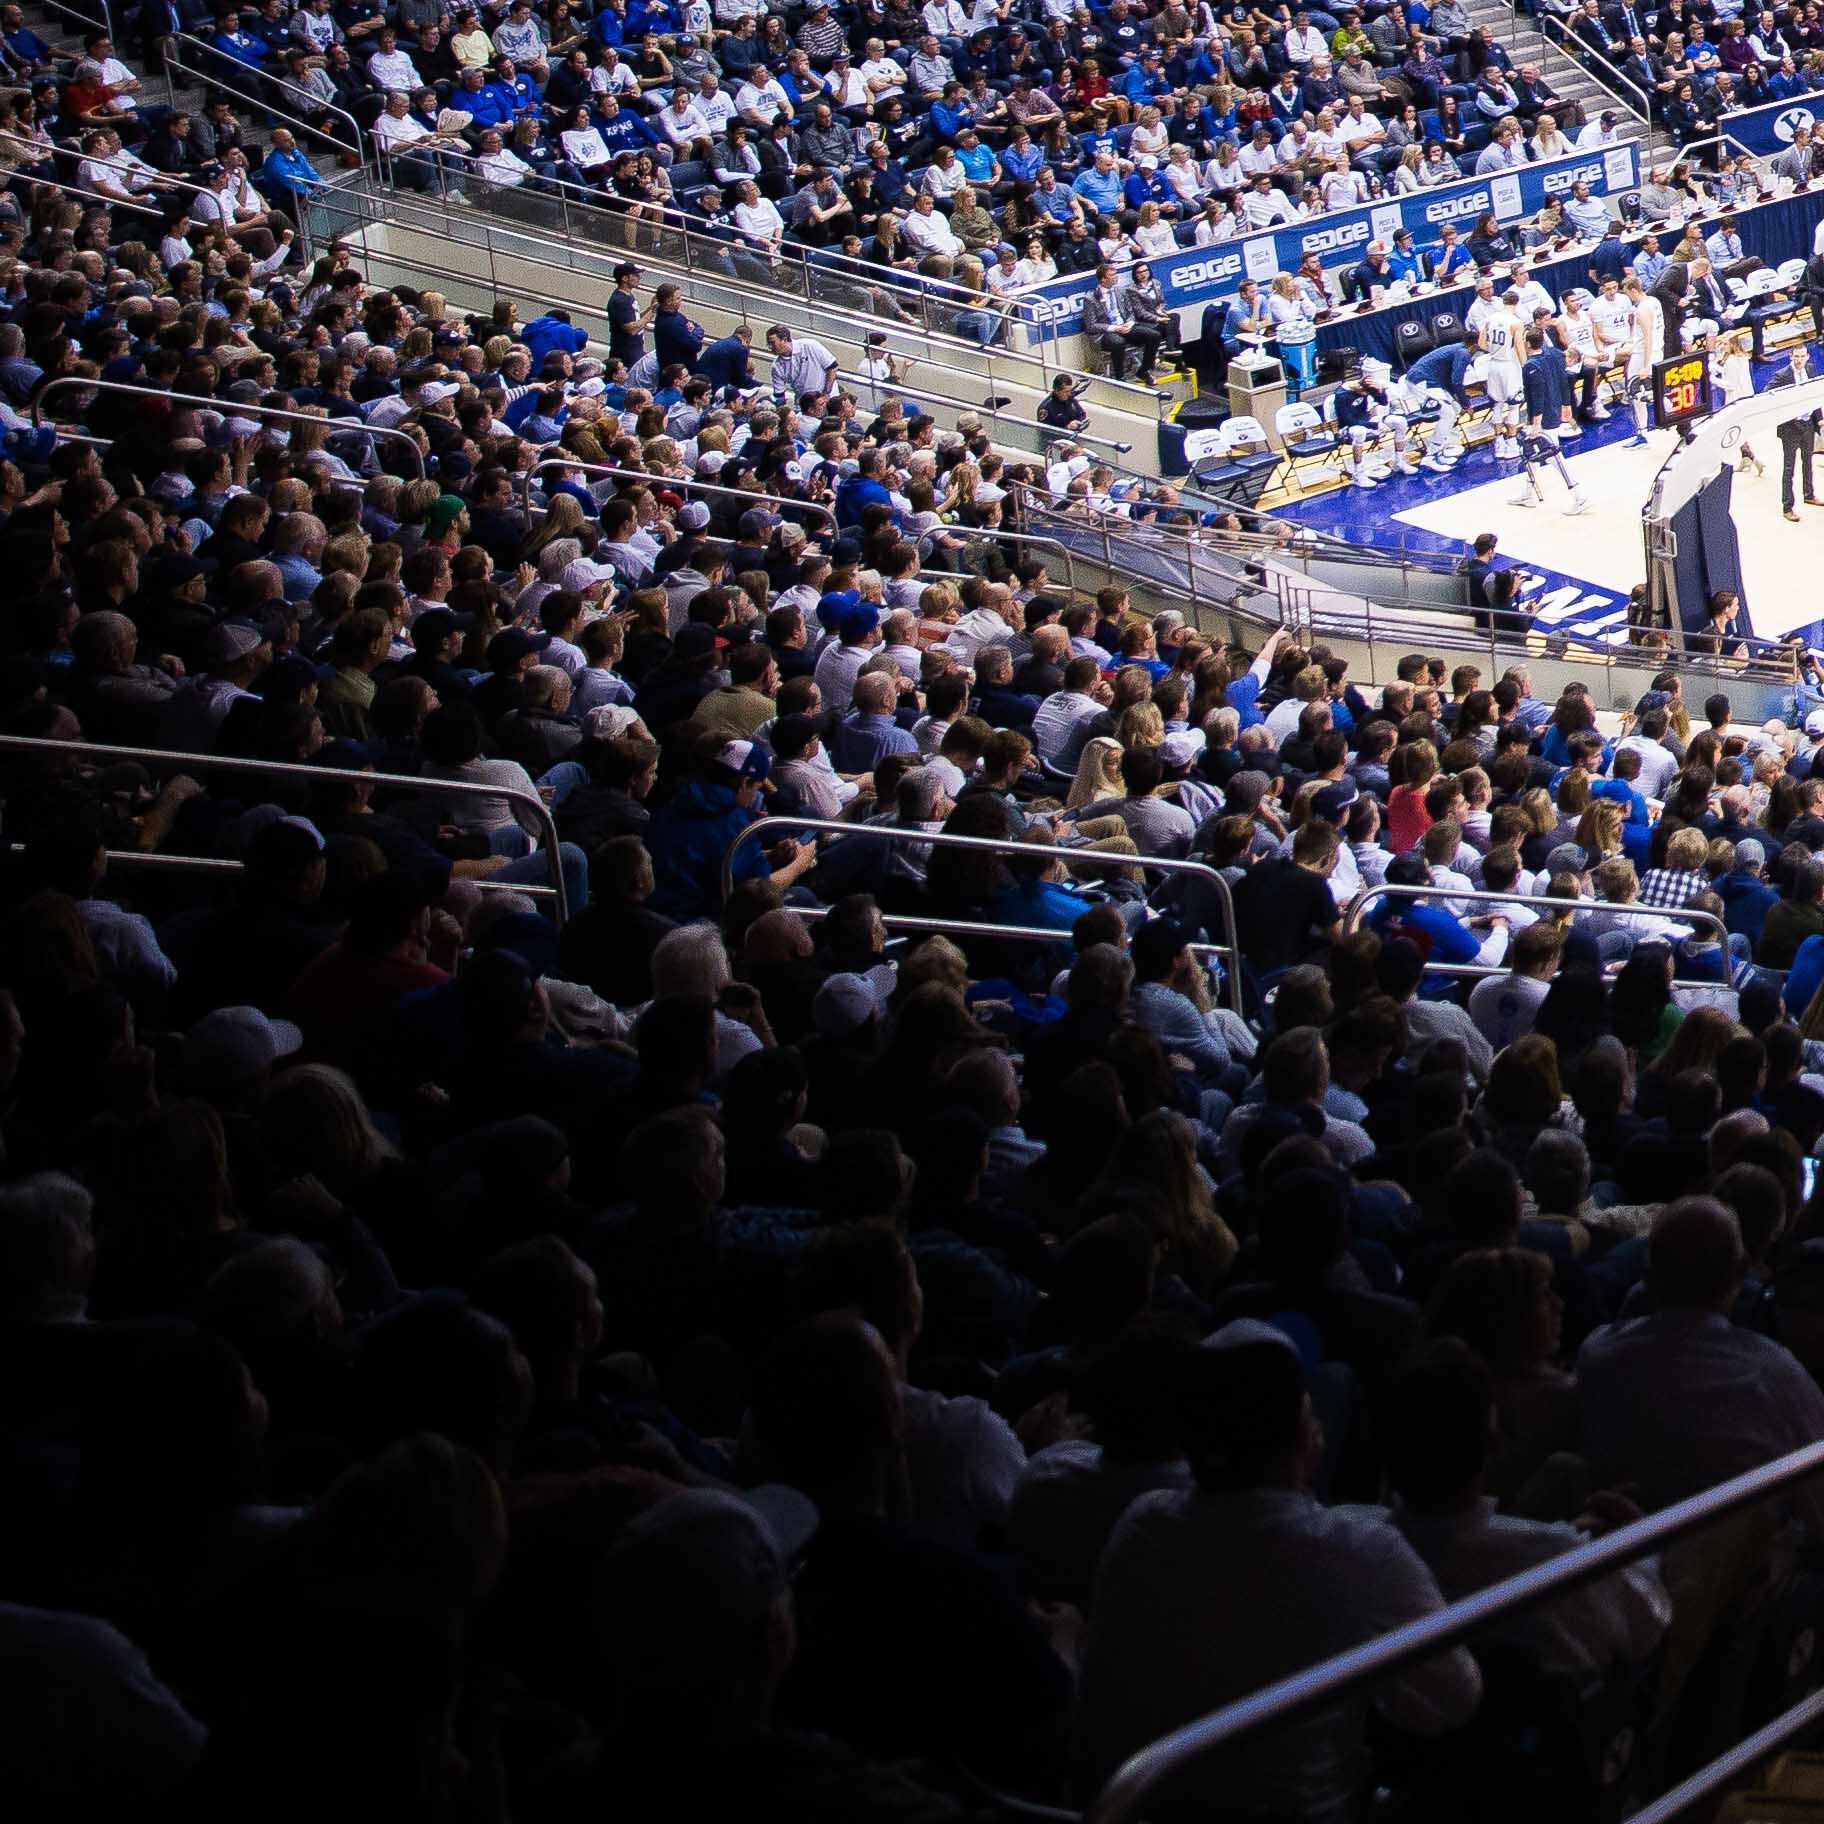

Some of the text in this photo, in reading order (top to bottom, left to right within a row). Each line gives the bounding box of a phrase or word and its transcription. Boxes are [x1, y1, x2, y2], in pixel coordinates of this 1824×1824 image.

[1613, 315, 1625, 328] 44
[1491, 329, 1508, 347] 10
[1576, 329, 1590, 341] 23
[1663, 384, 1696, 414] 30
